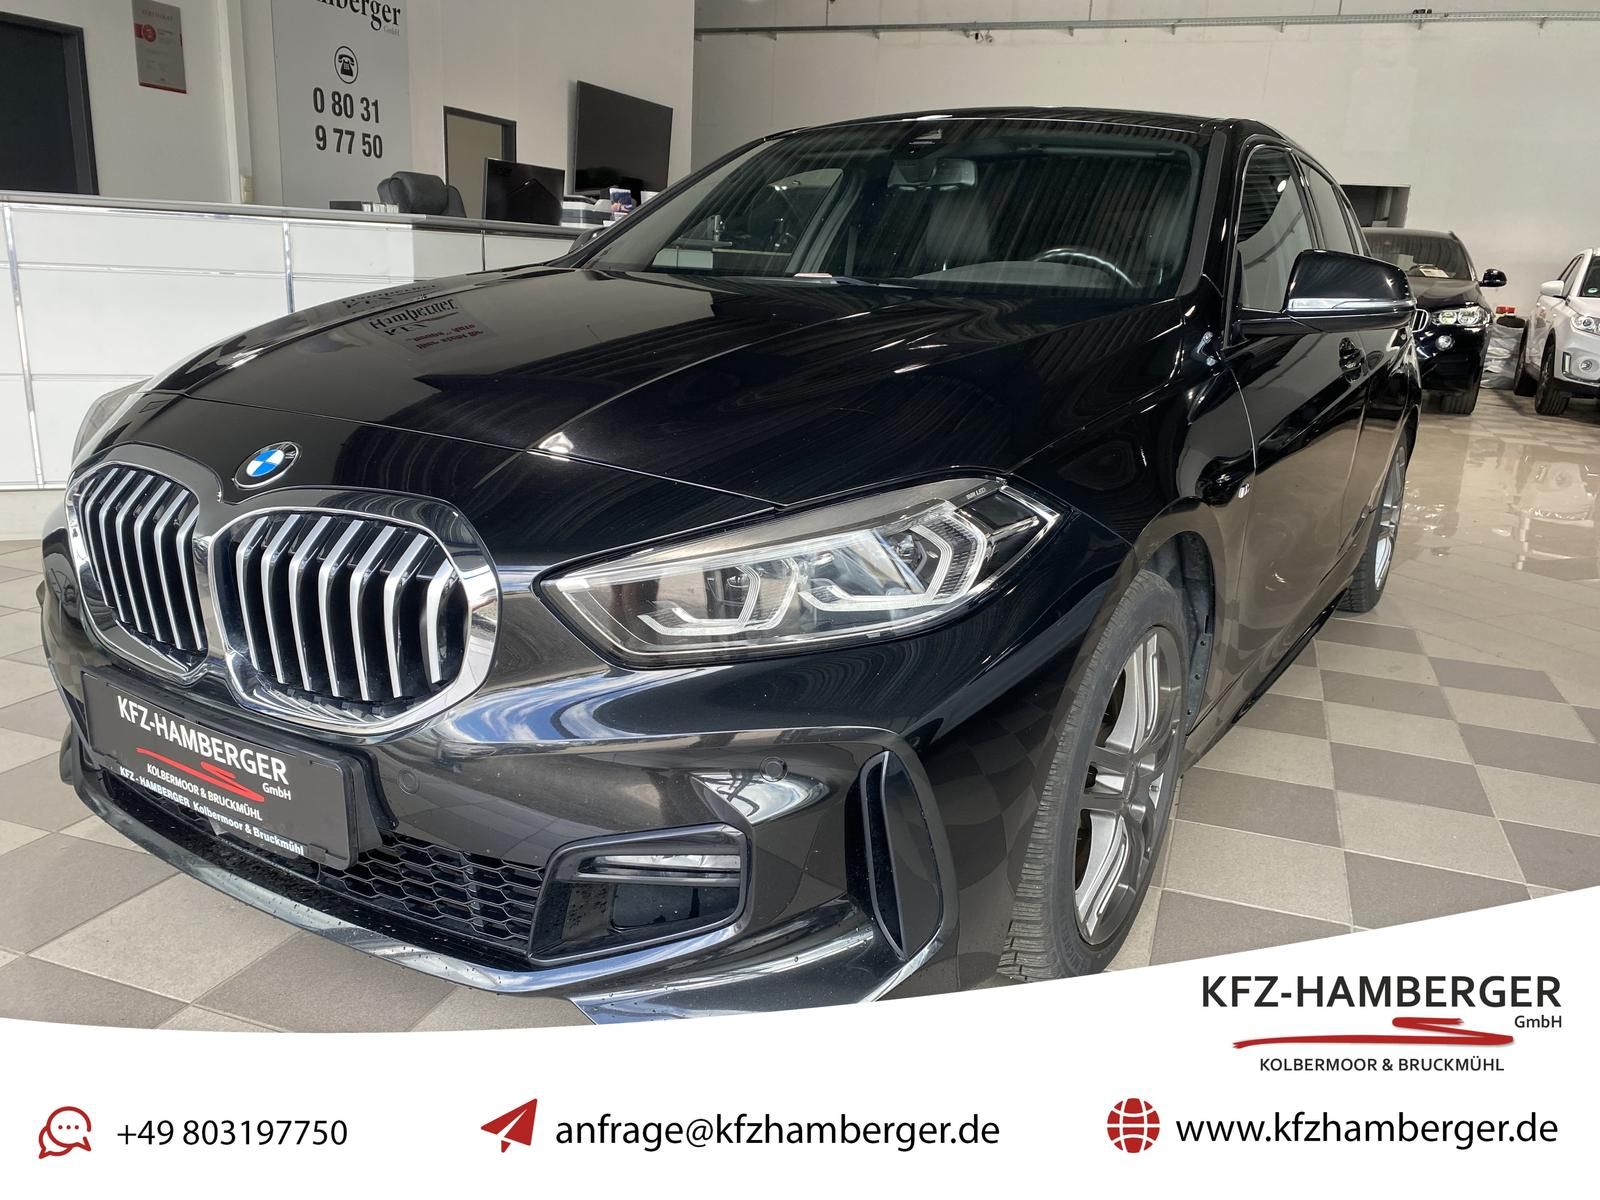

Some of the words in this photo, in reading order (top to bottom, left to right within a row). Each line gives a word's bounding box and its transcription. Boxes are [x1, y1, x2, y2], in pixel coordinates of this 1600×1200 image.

[313, 87, 325, 113] 0
[331, 91, 354, 119] 80
[360, 97, 379, 124] 31
[315, 125, 327, 151] 9
[333, 128, 355, 154] 77
[362, 133, 383, 159] 50
[117, 695, 289, 785] KFZ-HAMBERGER
[119, 766, 136, 782] KFZ
[139, 776, 191, 808] HAMBERGER
[192, 801, 244, 831] Kolbermoor
[244, 823, 252, 835] &
[252, 827, 305, 857] Bruckmühl
[147, 763, 200, 796] KOLBERMOOR
[200, 787, 207, 799] &
[207, 792, 263, 822] BRUCKMÜHL
[262, 782, 292, 801] GmbH
